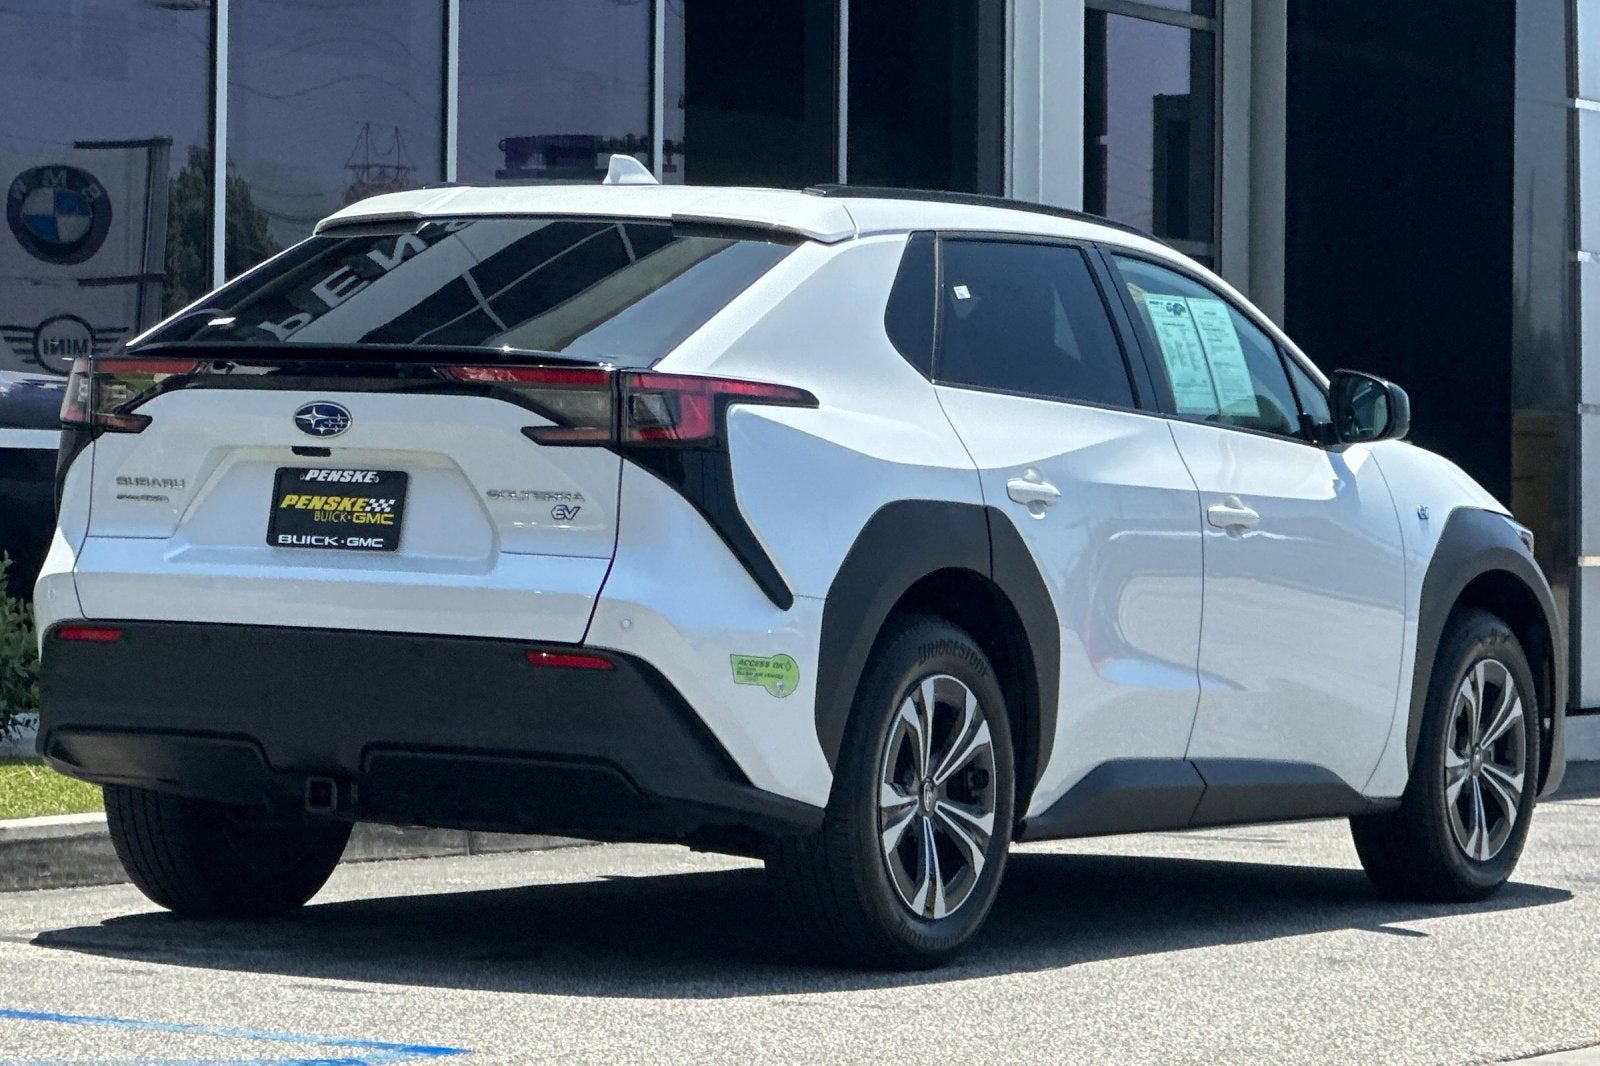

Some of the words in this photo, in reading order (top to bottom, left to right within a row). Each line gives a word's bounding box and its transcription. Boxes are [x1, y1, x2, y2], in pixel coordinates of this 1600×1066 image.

[305, 469, 377, 483] PENSKE
[280, 494, 368, 512] PENSKE
[551, 504, 581, 520] EV
[738, 659, 770, 668] ACCESS
